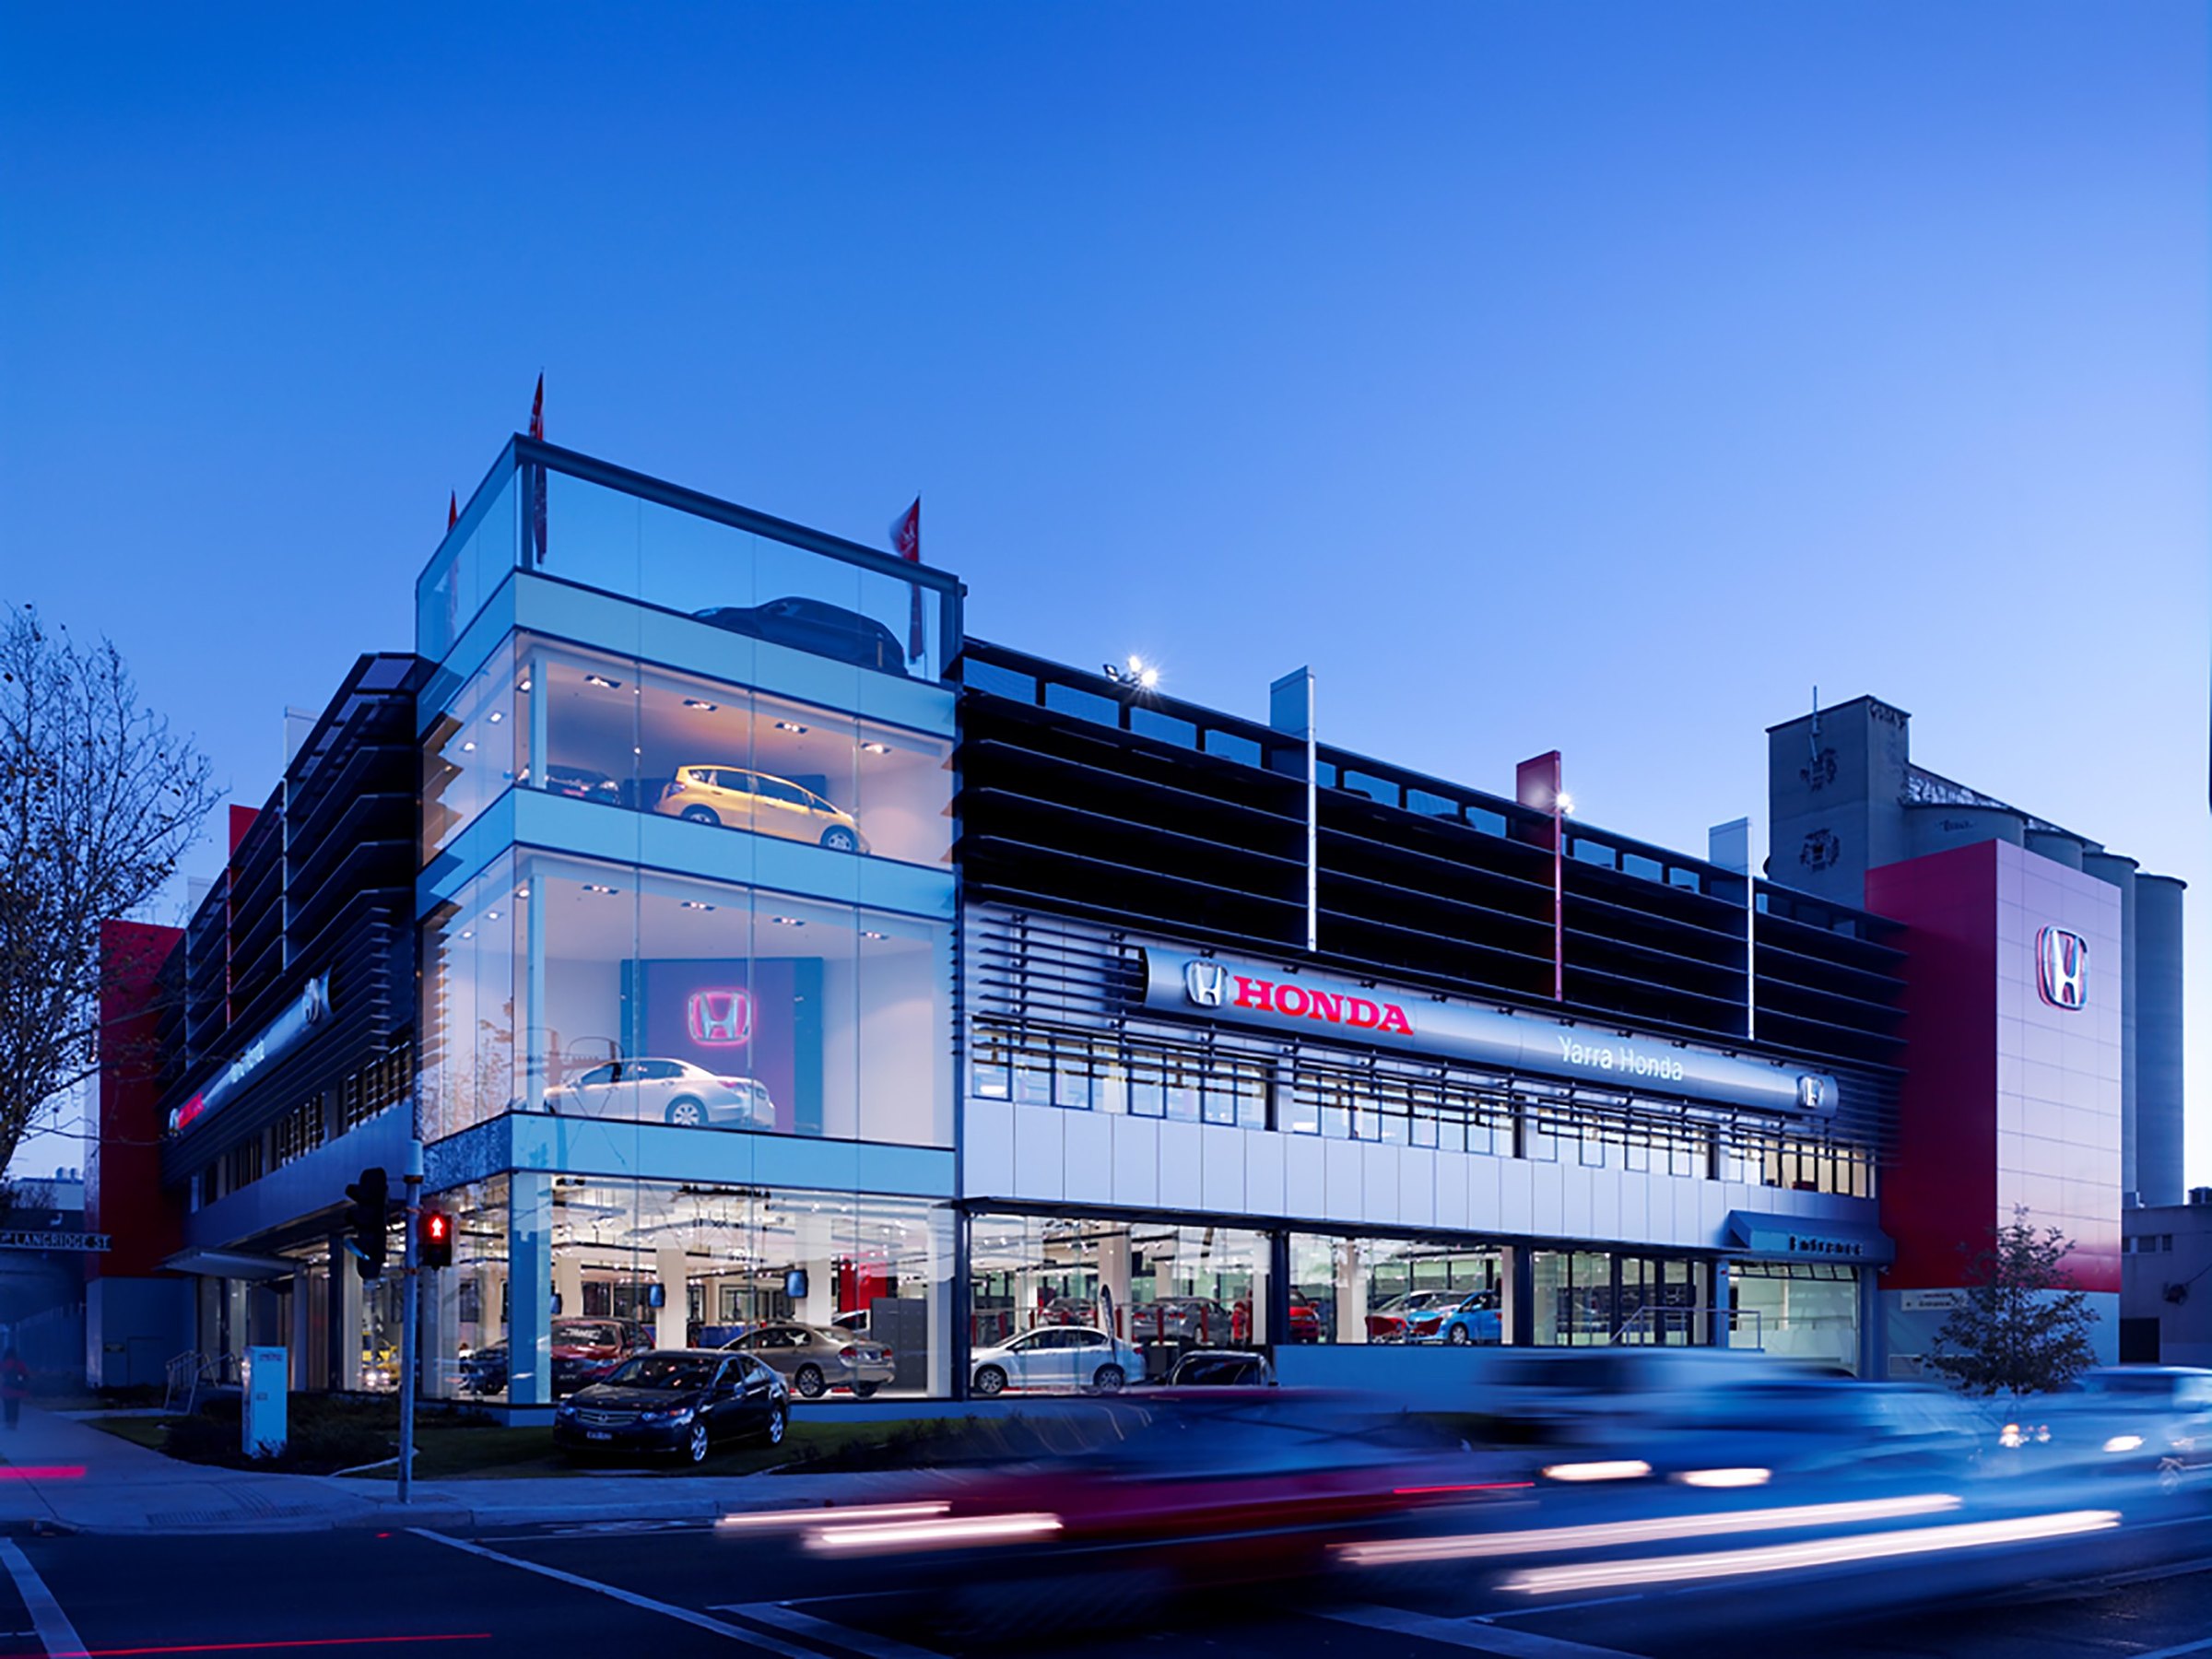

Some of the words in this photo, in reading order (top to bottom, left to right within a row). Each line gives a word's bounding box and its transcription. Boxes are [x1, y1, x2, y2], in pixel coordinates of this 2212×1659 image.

[1233, 975, 1414, 1036] HONDA
[1558, 1036, 1613, 1069] Yarra
[1619, 1047, 1684, 1081] Honda
[15, 1233, 88, 1249] LANGRIDGE
[95, 1234, 111, 1250] ST
[1789, 1236, 1864, 1255] Entrance
